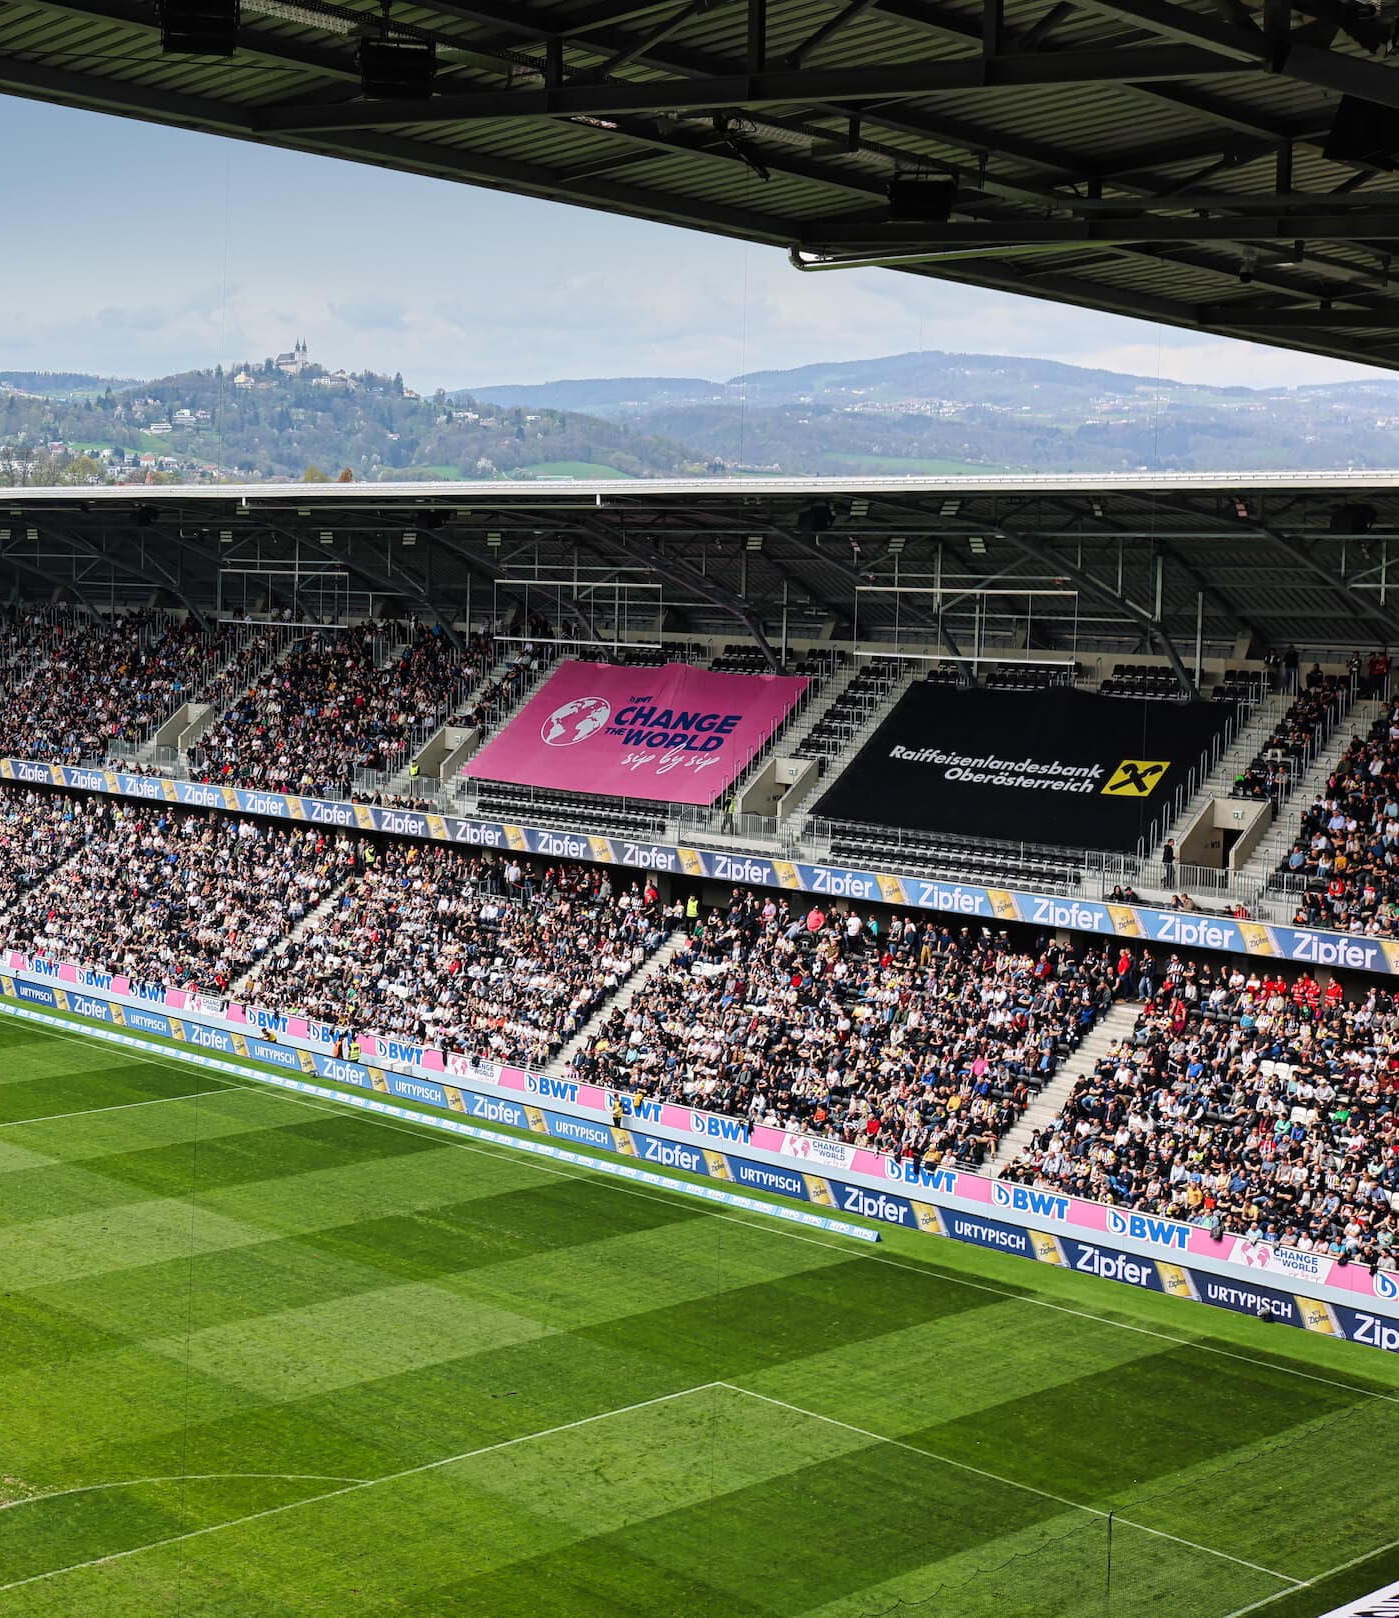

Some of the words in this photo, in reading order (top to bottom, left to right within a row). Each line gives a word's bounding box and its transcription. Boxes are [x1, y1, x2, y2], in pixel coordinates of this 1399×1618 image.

[614, 706, 742, 735] CHANGE
[604, 726, 626, 737] THE
[622, 728, 724, 752] WORLD
[621, 750, 655, 771] sip
[656, 743, 688, 774] by
[686, 751, 721, 773] sip
[889, 744, 1104, 779] Raiffeisenlandesbank
[18, 763, 49, 782] Zipfer
[71, 770, 102, 790] Zipfer
[944, 767, 1094, 795] Oberösterreich
[126, 777, 159, 798] Zipfer
[185, 785, 219, 807] Zipfer
[246, 794, 283, 816] Zipfer
[311, 802, 352, 826] Zipfer
[382, 812, 425, 836] Zipfer
[455, 821, 502, 846] Zipfer
[537, 832, 587, 858] Zipfer
[623, 843, 676, 870] Zipfer
[714, 855, 771, 884] Zipfer
[813, 868, 873, 898] Zipfer
[919, 883, 984, 914] Zipfer
[1033, 898, 1103, 931] Zipfer
[1158, 915, 1235, 948] Zipfer
[1293, 932, 1377, 969] Zipfer
[20, 986, 52, 1002] URTYPISCH
[86, 972, 112, 991] BWT
[74, 996, 107, 1020] Zipfer
[131, 1014, 167, 1032] URTYPISCH
[257, 1012, 288, 1033] BWT
[191, 1025, 228, 1050] Zipfer
[255, 1046, 295, 1065] URTYPISCH
[388, 1042, 423, 1066] BWT
[323, 1059, 365, 1086] Zipfer
[395, 1080, 441, 1102] URTYPISCH
[538, 1077, 579, 1104] BWT
[473, 1096, 521, 1126] Zipfer
[622, 1095, 663, 1123] BWT
[555, 1121, 608, 1144] URTYPISCH
[707, 1117, 750, 1144] BWT
[645, 1138, 700, 1170] Zipfer
[813, 1140, 845, 1154] CHANGE
[819, 1150, 845, 1161] WORLD
[739, 1166, 801, 1193] URTYPISCH
[905, 1163, 956, 1192] BWT
[844, 1186, 908, 1224] Zipfer
[1013, 1188, 1070, 1220] BWT
[830, 1220, 850, 1233] HYPO
[853, 1227, 874, 1239] HYPO
[954, 1220, 1026, 1250] URTYPISCH
[1129, 1215, 1191, 1249] BWT
[1077, 1245, 1152, 1286] Zipfer
[1273, 1248, 1319, 1266] CHANGE
[1282, 1259, 1319, 1274] WORLD
[1207, 1284, 1293, 1318] URTYPISCH
[1308, 1314, 1330, 1326] Zipfer
